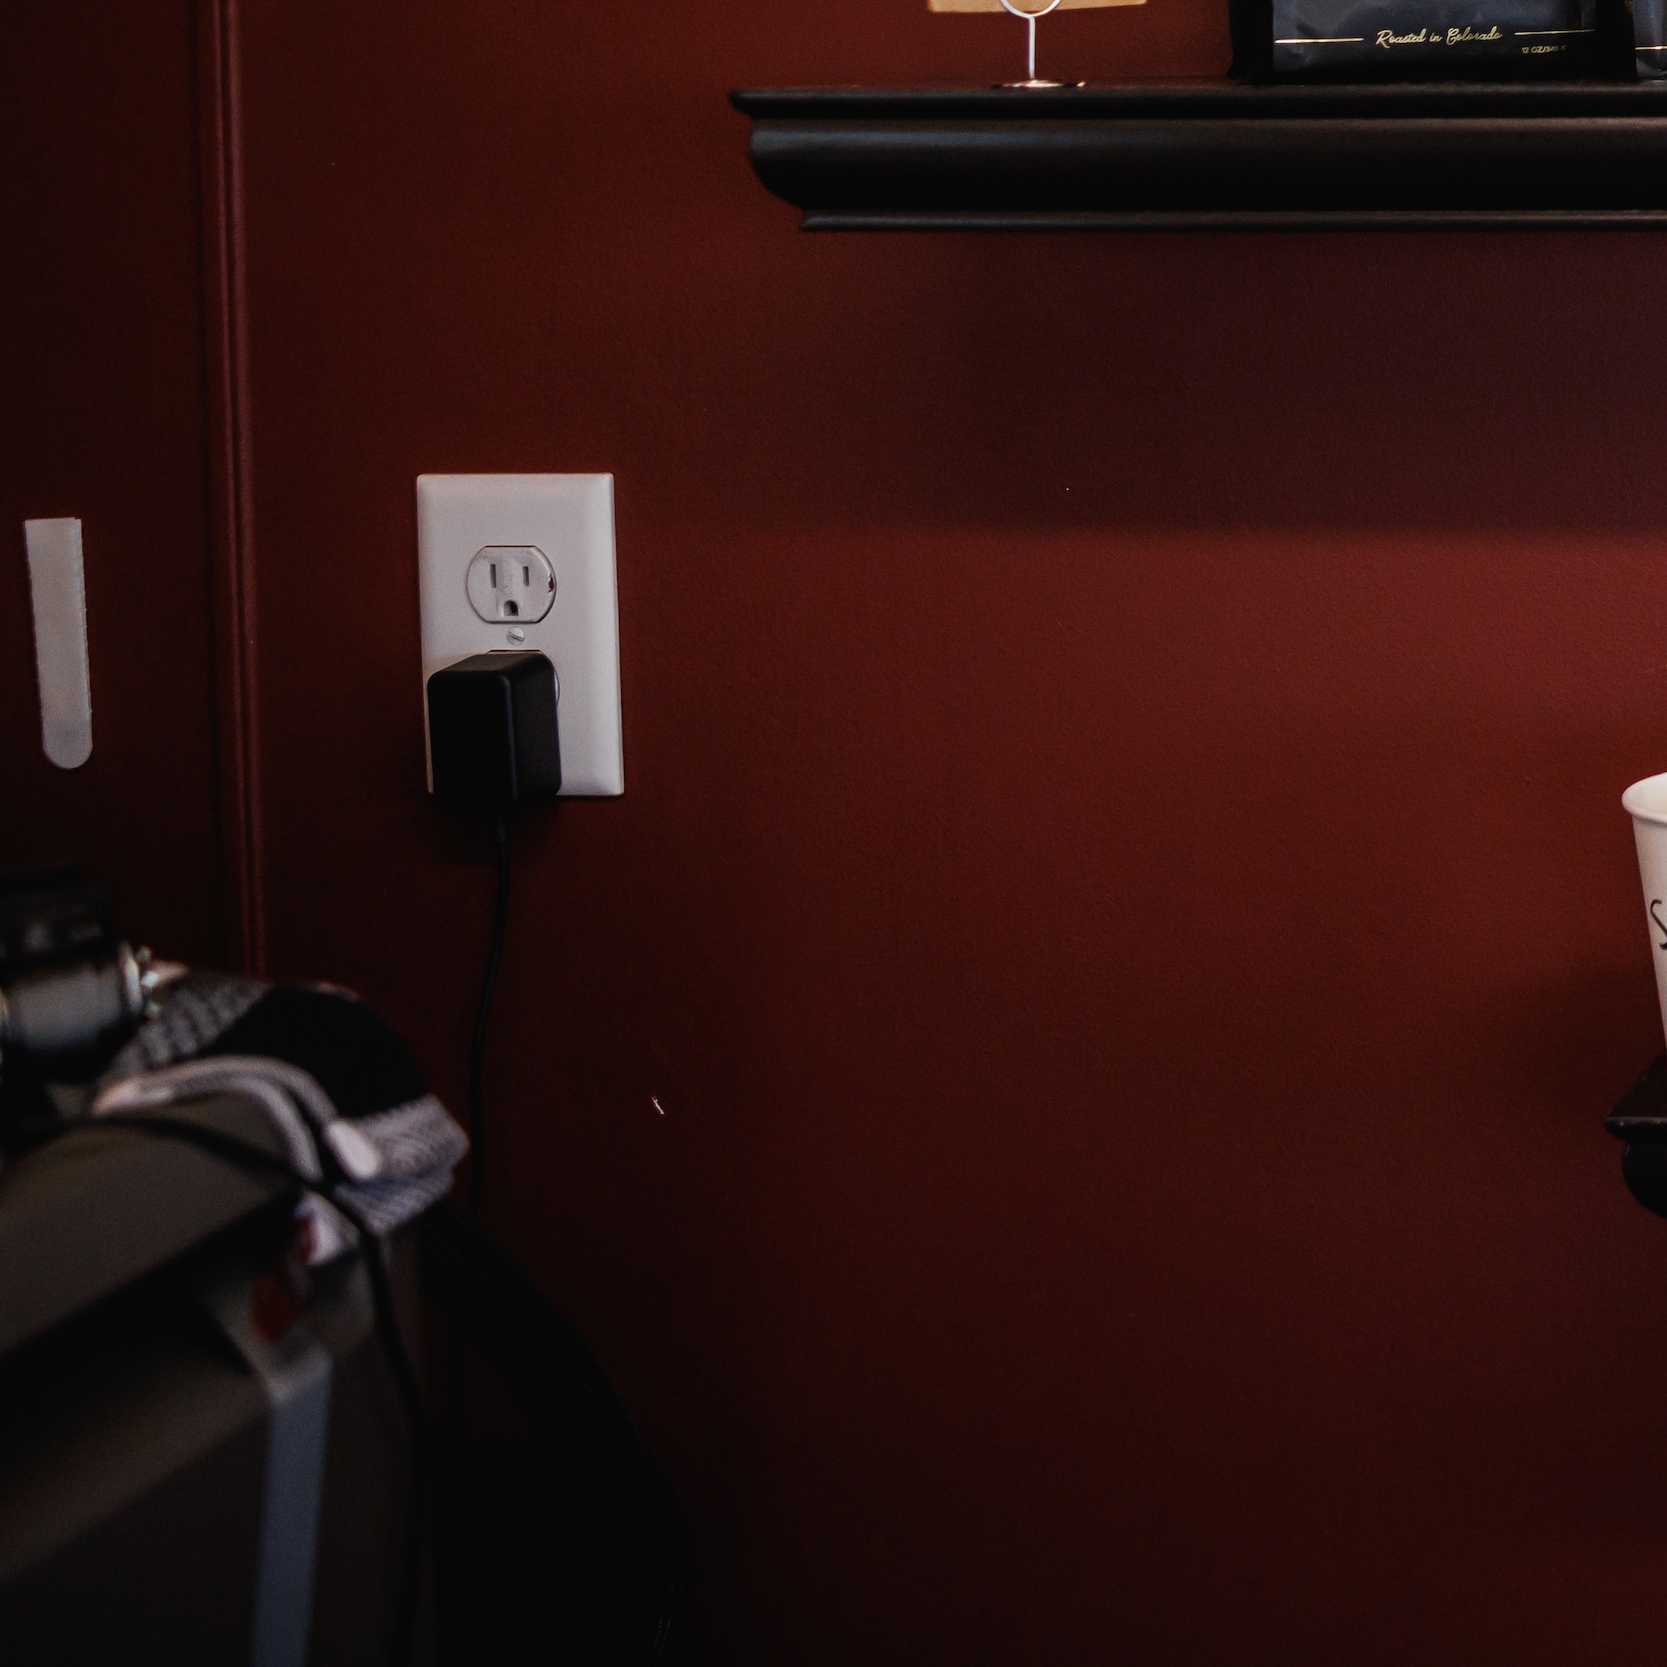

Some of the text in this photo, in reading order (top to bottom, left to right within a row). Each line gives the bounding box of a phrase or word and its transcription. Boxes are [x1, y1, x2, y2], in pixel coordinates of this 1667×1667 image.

[1376, 26, 1503, 49] Roasted in Colorado
